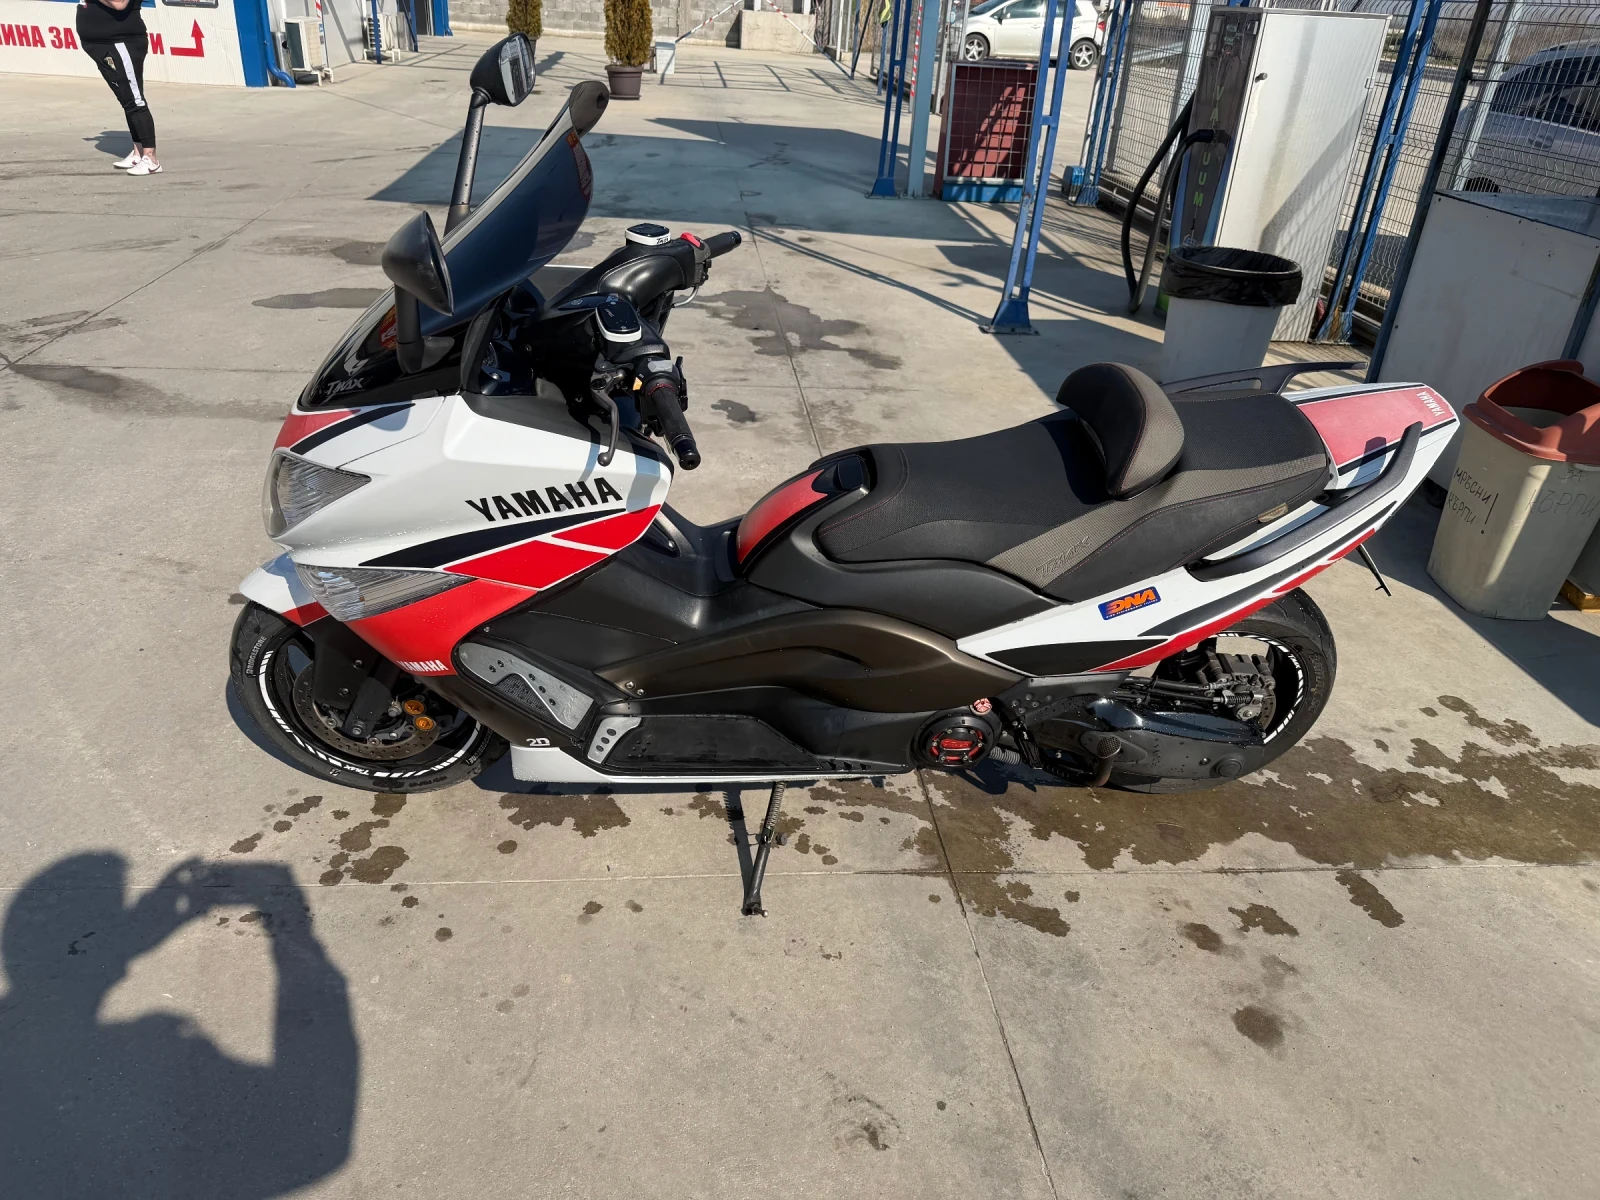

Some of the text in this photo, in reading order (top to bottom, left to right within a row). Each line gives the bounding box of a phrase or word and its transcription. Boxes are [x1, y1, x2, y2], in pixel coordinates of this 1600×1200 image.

[0, 24, 78, 50] ИНА ЗА
[1193, 85, 1225, 207] VAUUM
[1416, 391, 1446, 417] YAMAHA
[465, 477, 623, 521] YAMAHA
[1106, 589, 1156, 615] DNA
[397, 659, 449, 672] YAMAHA
